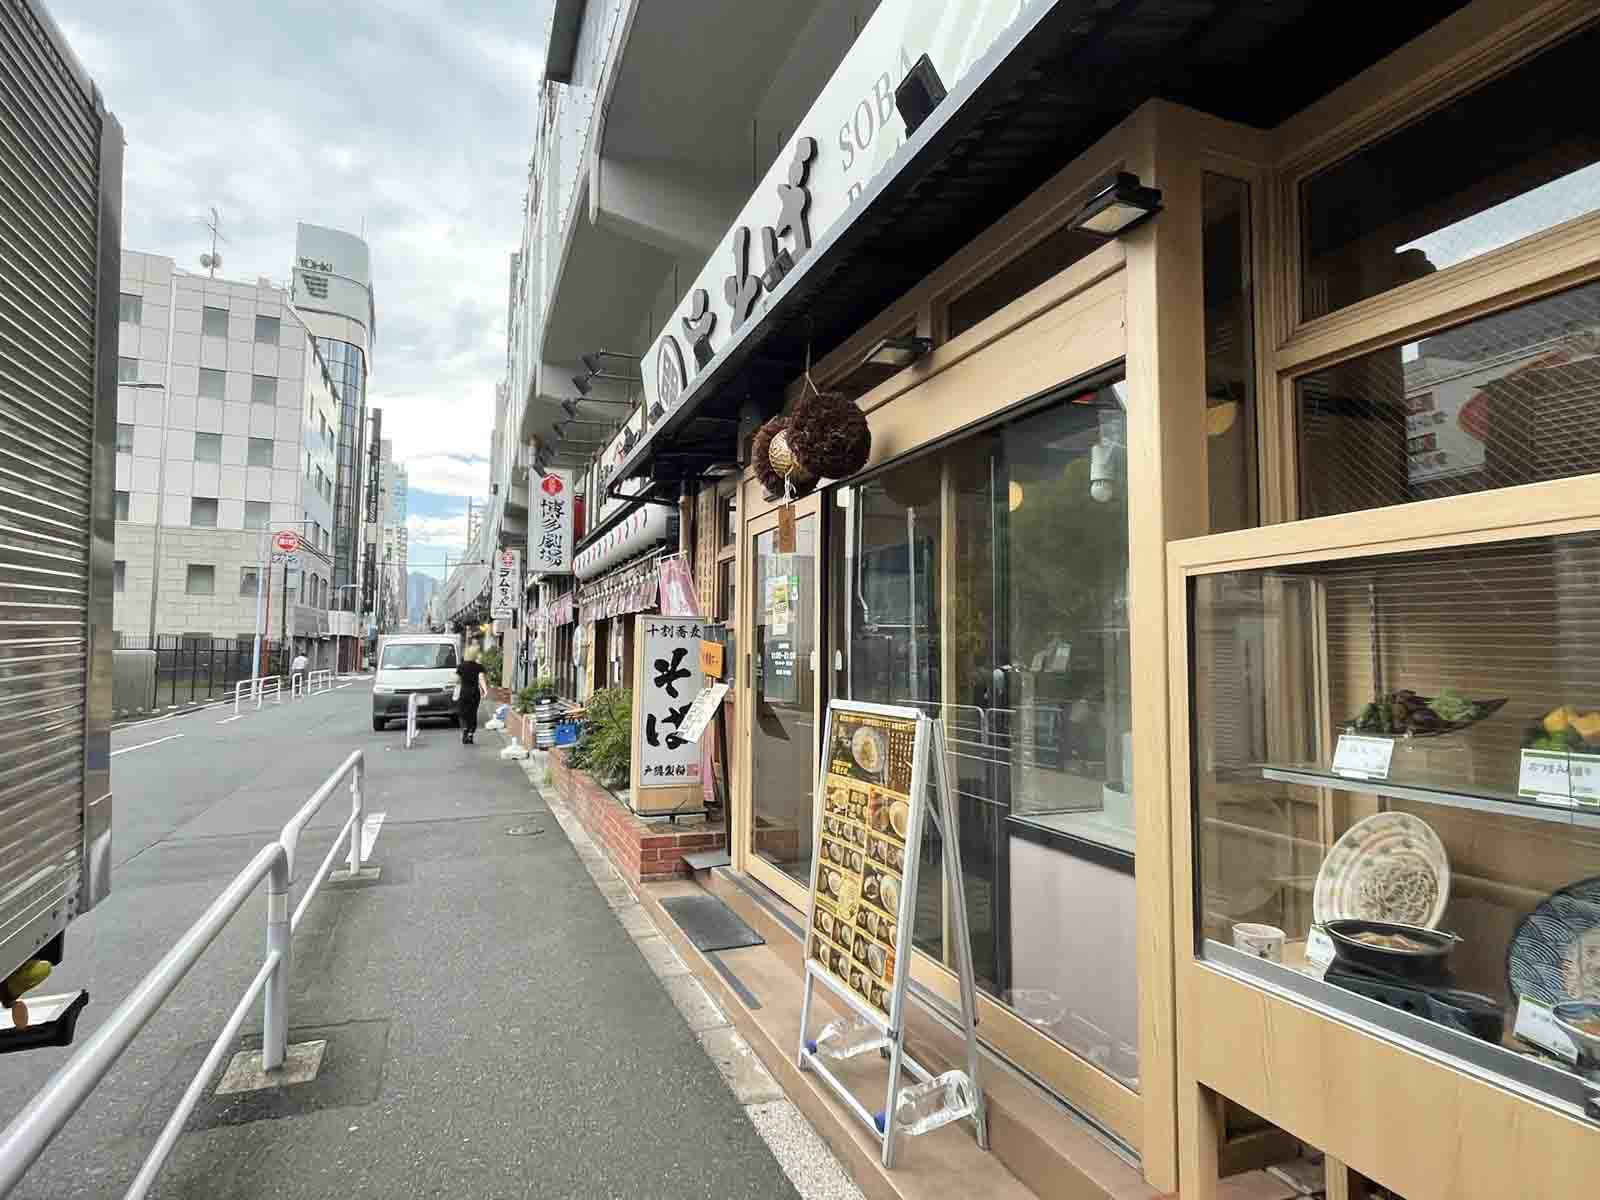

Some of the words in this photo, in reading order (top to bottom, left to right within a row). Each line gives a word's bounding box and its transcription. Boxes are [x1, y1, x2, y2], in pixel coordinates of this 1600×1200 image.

[538, 498, 565, 568] 博多劇場
[646, 647, 692, 750] そば
